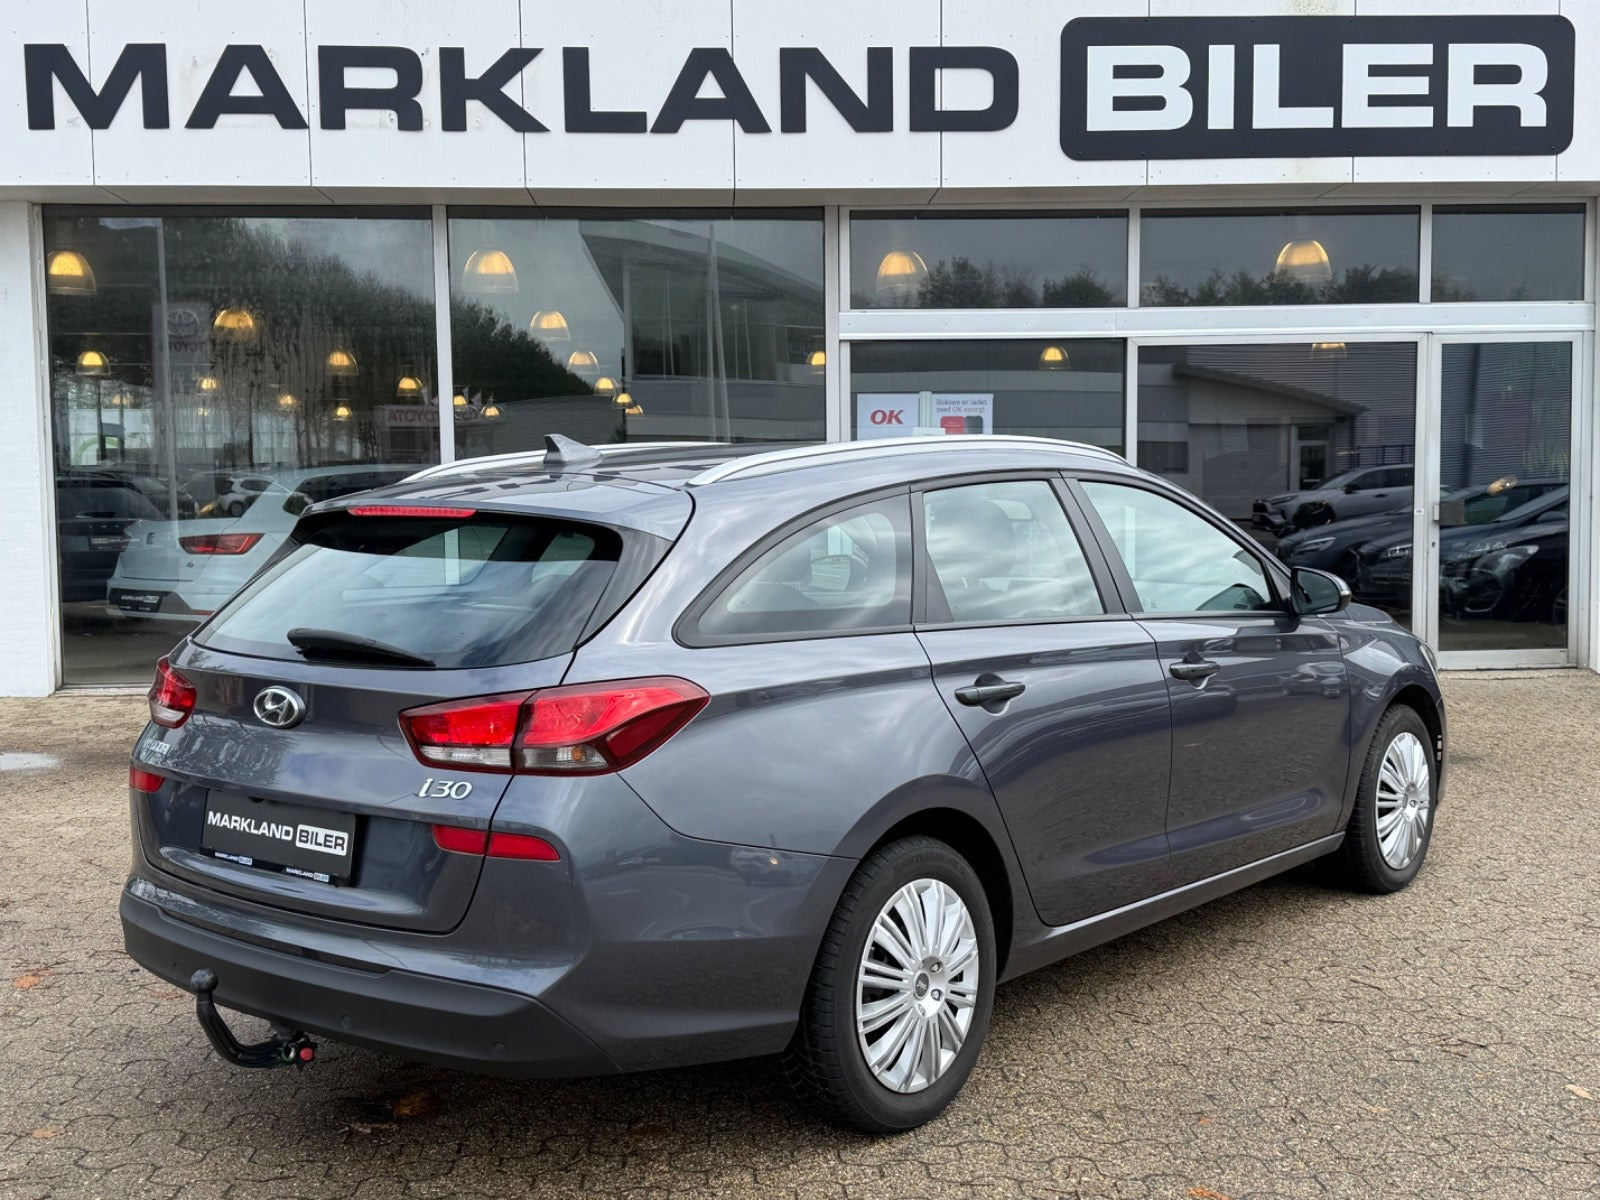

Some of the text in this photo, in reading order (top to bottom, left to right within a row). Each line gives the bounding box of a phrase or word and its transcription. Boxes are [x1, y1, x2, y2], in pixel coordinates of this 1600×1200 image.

[24, 43, 1548, 134] MARKLAND BILER
[870, 409, 904, 425] OK
[419, 778, 473, 800] i30
[207, 810, 346, 851] MARKLAND BILER
